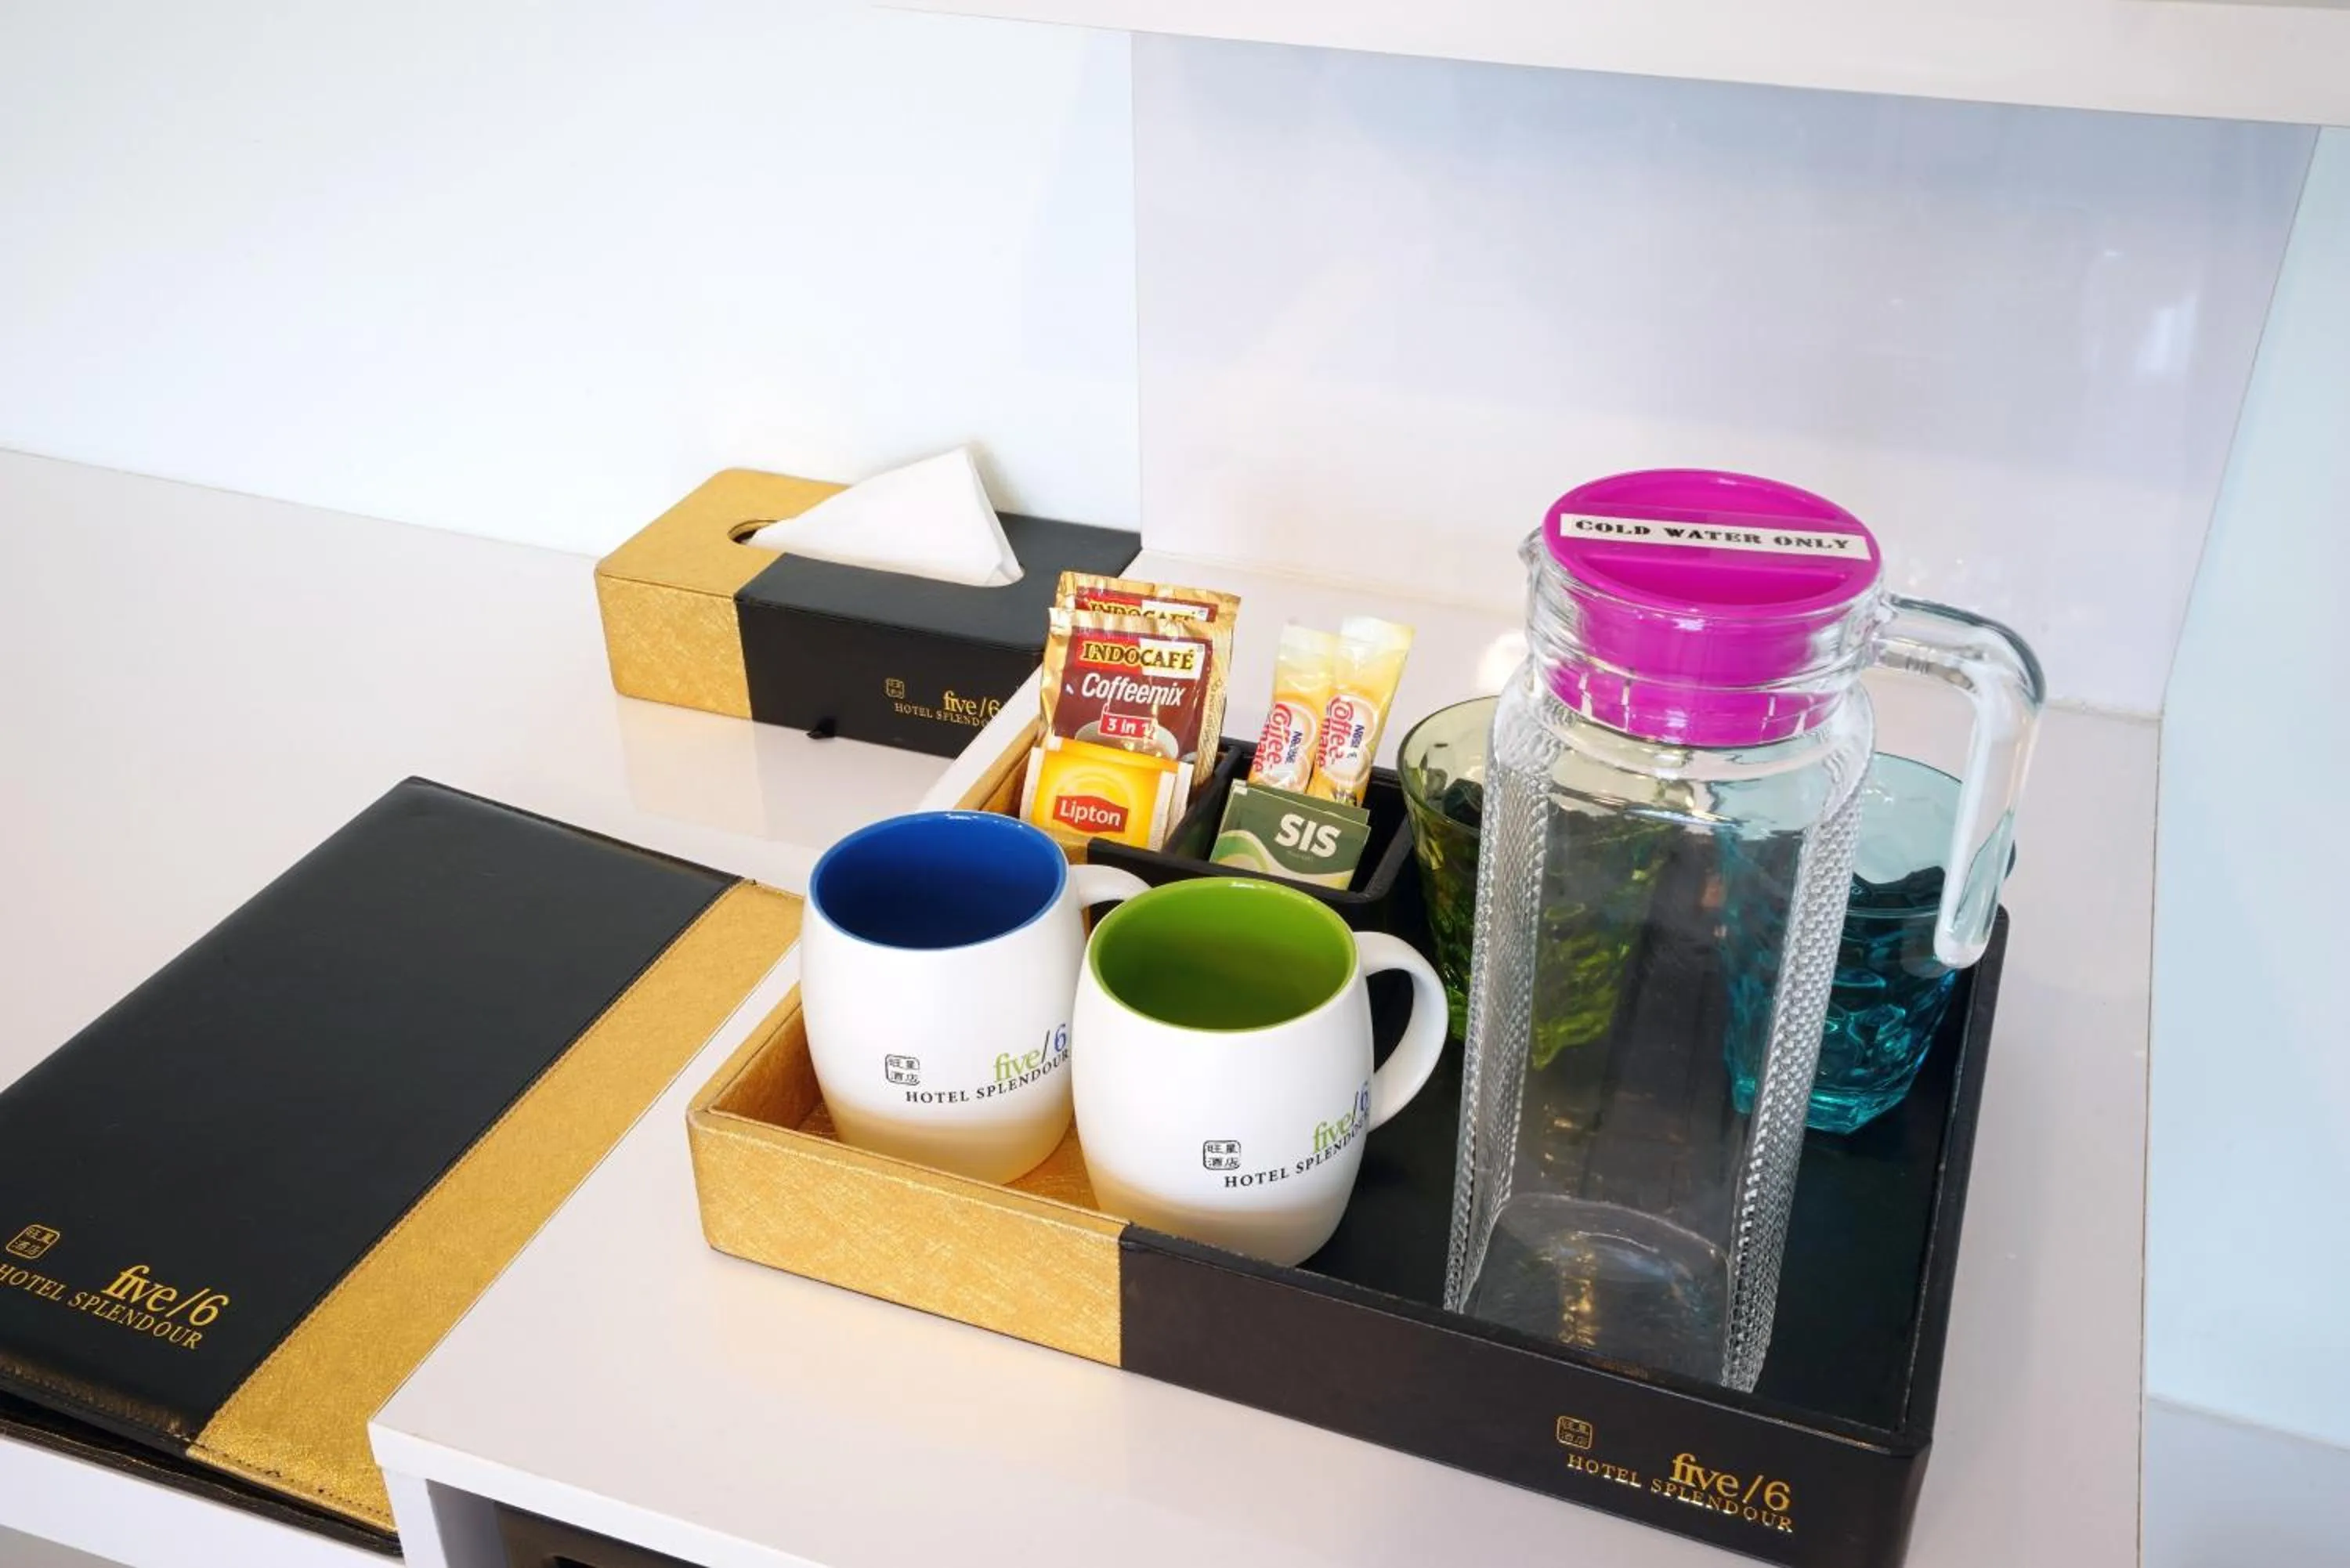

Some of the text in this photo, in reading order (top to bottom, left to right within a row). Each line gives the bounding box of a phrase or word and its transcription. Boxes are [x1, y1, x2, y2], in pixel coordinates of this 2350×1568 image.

[1575, 519, 1849, 549] COLD WATER ONLY
[1083, 642, 1195, 670] INDOCAFÉ
[1081, 672, 1186, 706] Coffeemix
[894, 703, 933, 719] HOTEL
[1106, 718, 1115, 732] 3
[1121, 720, 1136, 734] in
[1059, 798, 1121, 827] Lipton
[1274, 812, 1342, 858] SIS
[906, 1048, 1069, 1104] HOTEL SPLENDOUR
[1224, 1168, 1290, 1188] HOTEL
[0, 1263, 204, 1349] HOTEL SPLENDOUR
[100, 1265, 230, 1326] five/6
[1567, 1454, 1793, 1533] HOTEL SPLENDOUR
[1669, 1453, 1791, 1512] five/6
